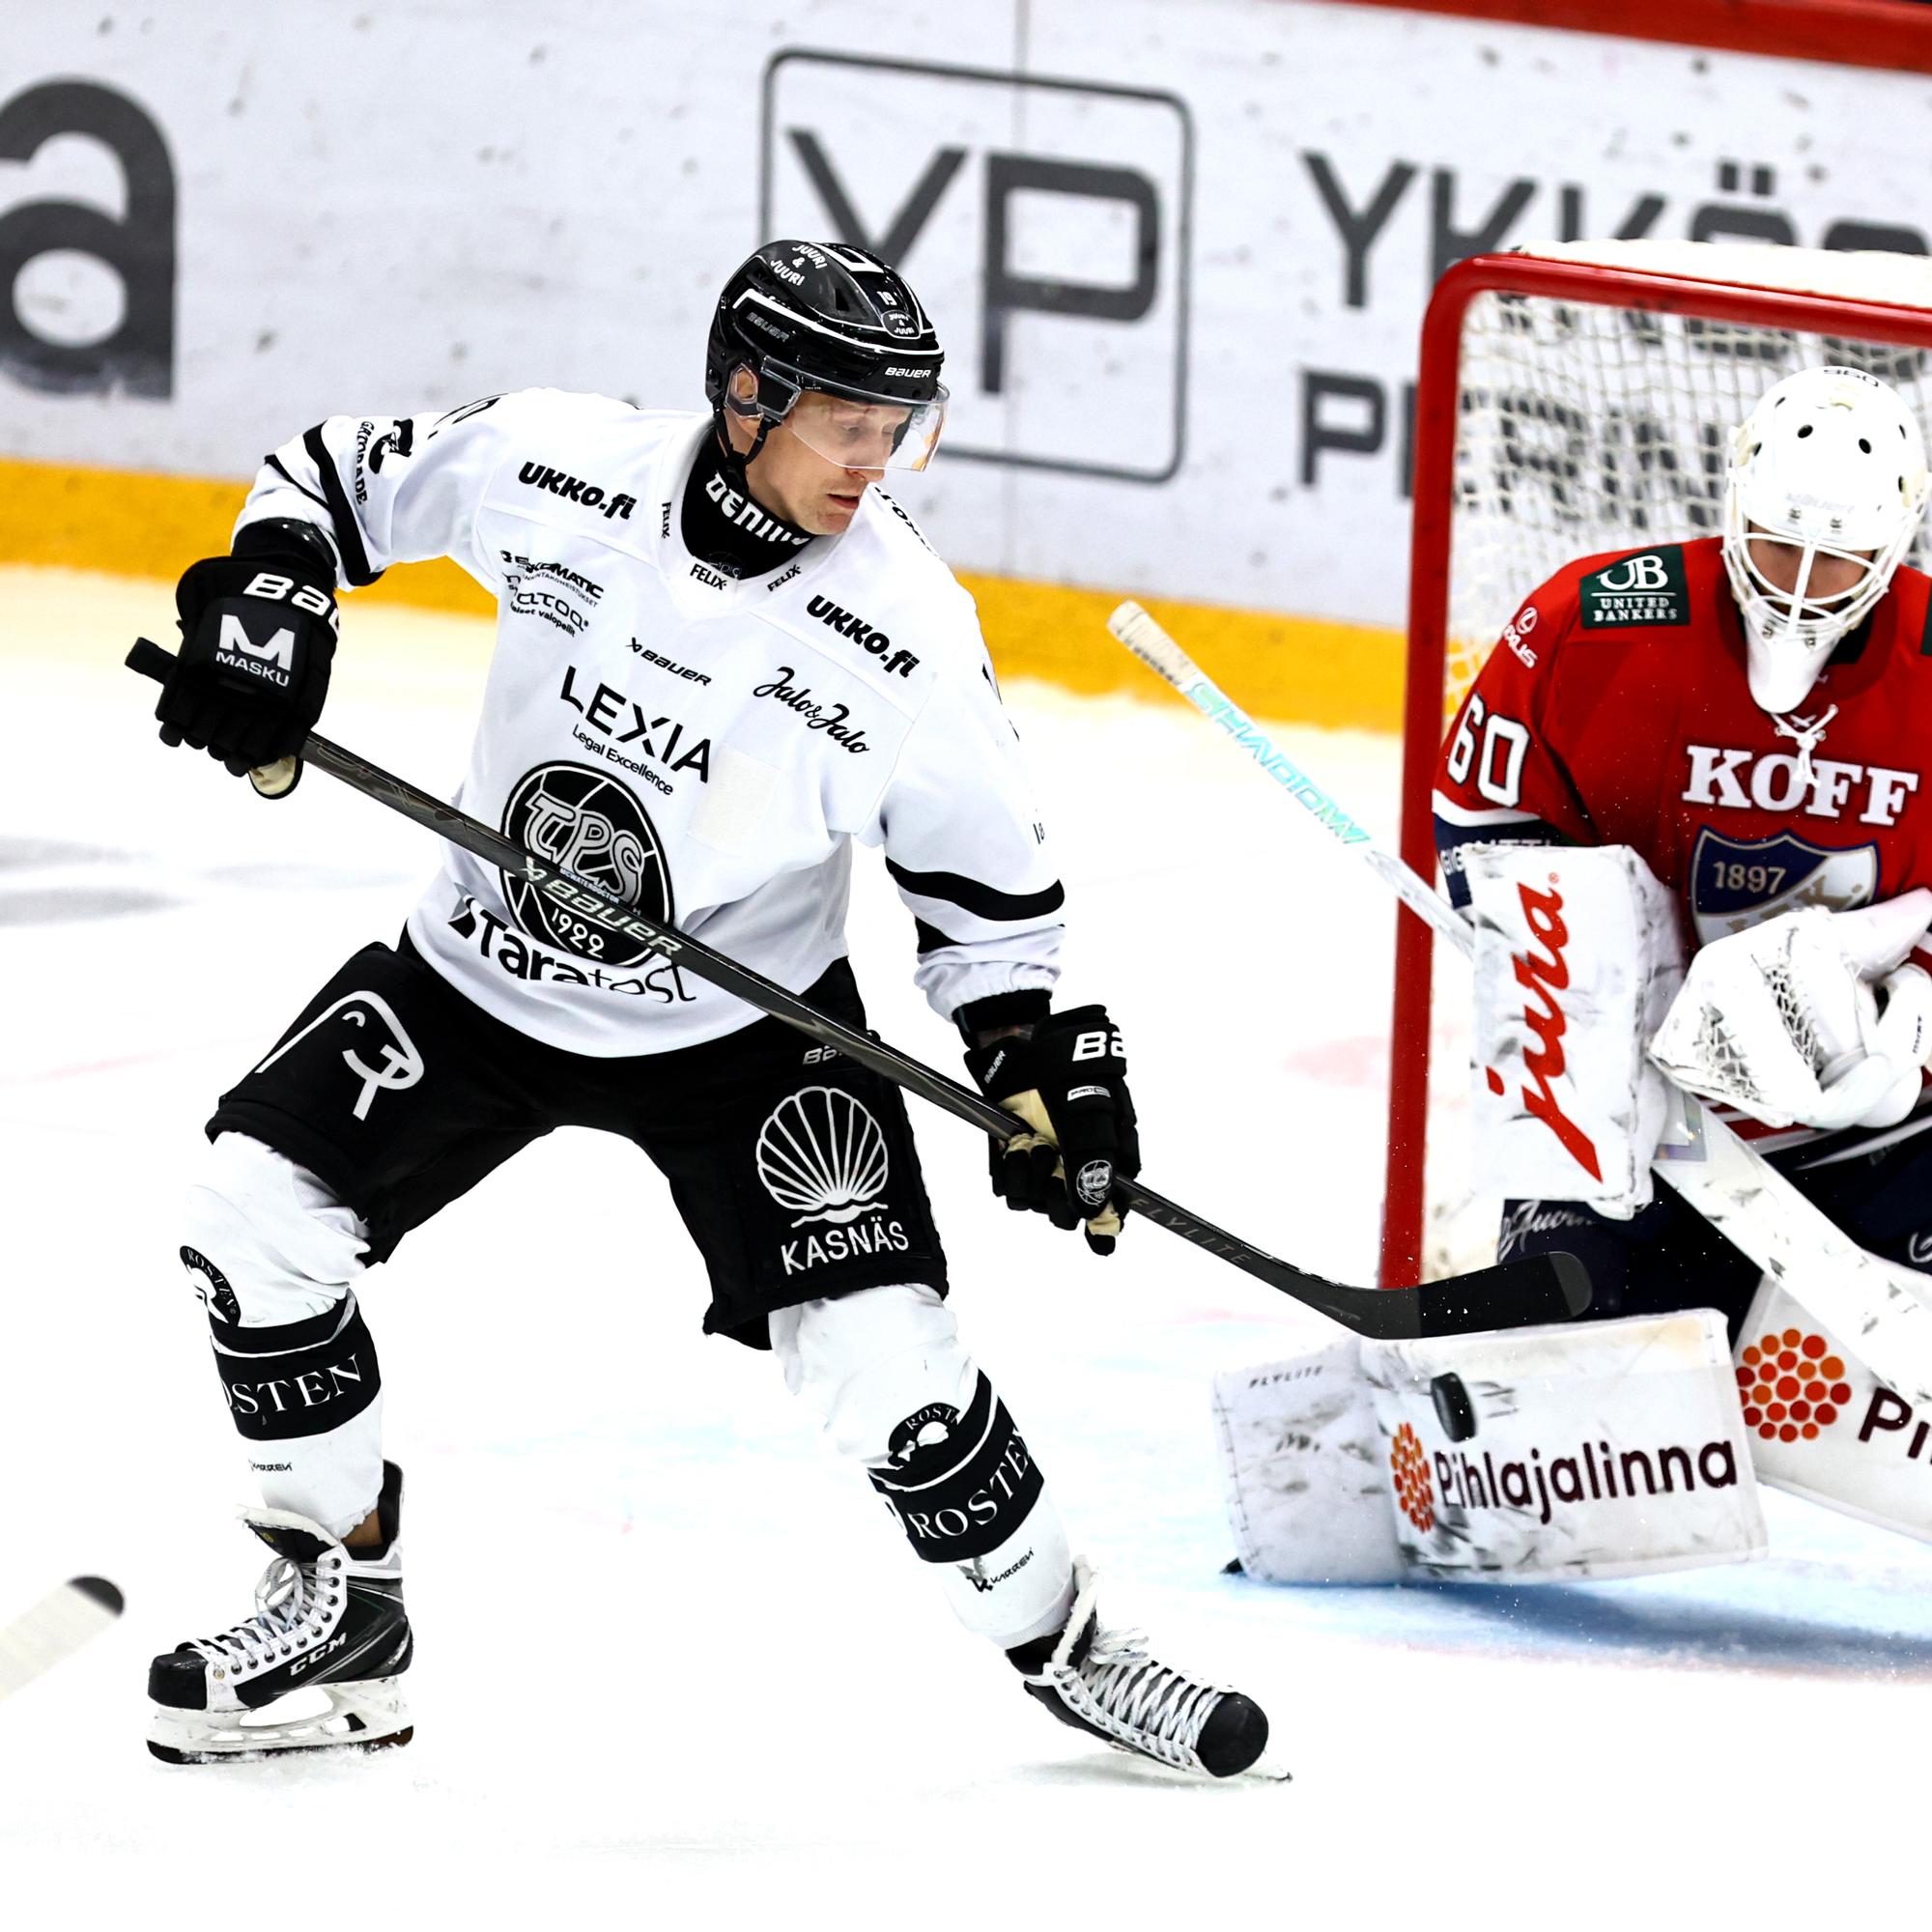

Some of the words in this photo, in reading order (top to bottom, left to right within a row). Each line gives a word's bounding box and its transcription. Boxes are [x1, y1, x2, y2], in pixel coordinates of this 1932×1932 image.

[771, 259, 806, 286] JUURI
[792, 244, 827, 270] JUURI
[792, 257, 802, 268] &
[876, 291, 897, 305] 19
[518, 462, 638, 520] UKKO.fi
[662, 501, 672, 538] FELIX
[690, 563, 725, 591] FELIX
[767, 564, 801, 592] FELIX
[1593, 609, 1678, 623] BANKERS
[1600, 596, 1670, 610] UNITED
[806, 595, 920, 678] UKKO.fi
[215, 651, 290, 687] MASKU
[560, 666, 711, 783] LEXIA
[573, 724, 606, 756] Legal
[606, 748, 673, 796] Excellence
[1447, 692, 1530, 809] 60
[1682, 745, 1918, 826] KOFF
[1712, 862, 1786, 895] 1897
[552, 908, 605, 959] 1922
[1485, 881, 1604, 1184] jura
[781, 1215, 909, 1275] KASNÄS
[1129, 1198, 1252, 1264] FLYLITE
[1434, 1439, 1738, 1525] Pihlajalinna
[290, 1633, 346, 1676] CCM
